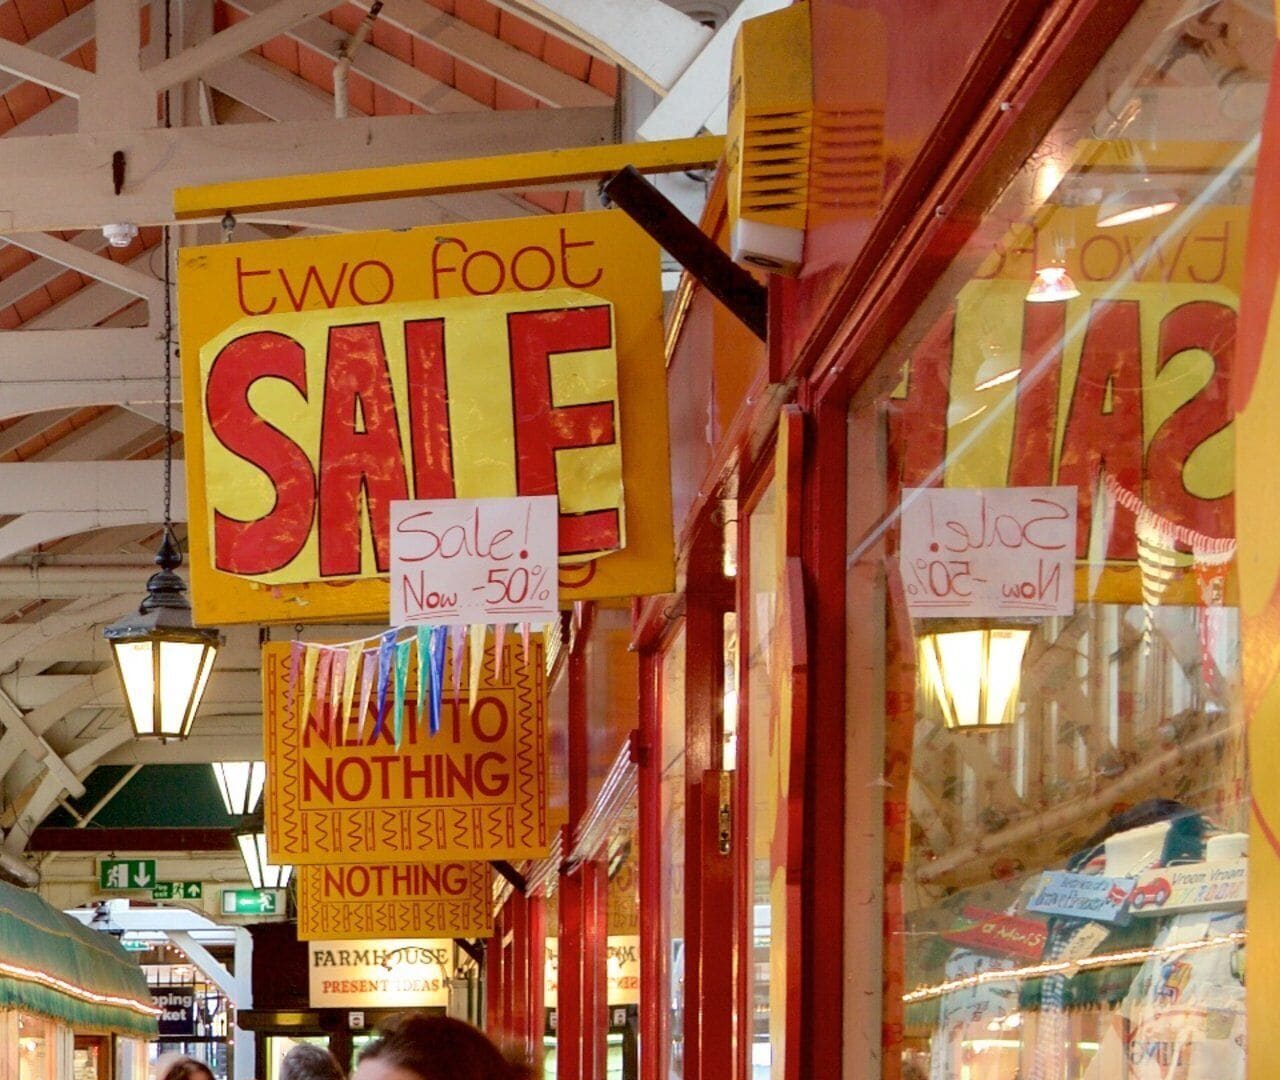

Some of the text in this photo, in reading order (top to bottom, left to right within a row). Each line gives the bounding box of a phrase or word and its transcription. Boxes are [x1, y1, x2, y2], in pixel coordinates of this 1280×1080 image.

[237, 229, 603, 315] two foot
[397, 503, 532, 562] Sale!
[403, 569, 458, 613] Now
[472, 565, 550, 604] -50%
[303, 697, 509, 749] NEXT TO
[303, 752, 510, 804] NOTHING
[324, 864, 468, 898] NOTHING
[314, 948, 449, 968] FARMHOUSE
[322, 979, 388, 994] PRESENT
